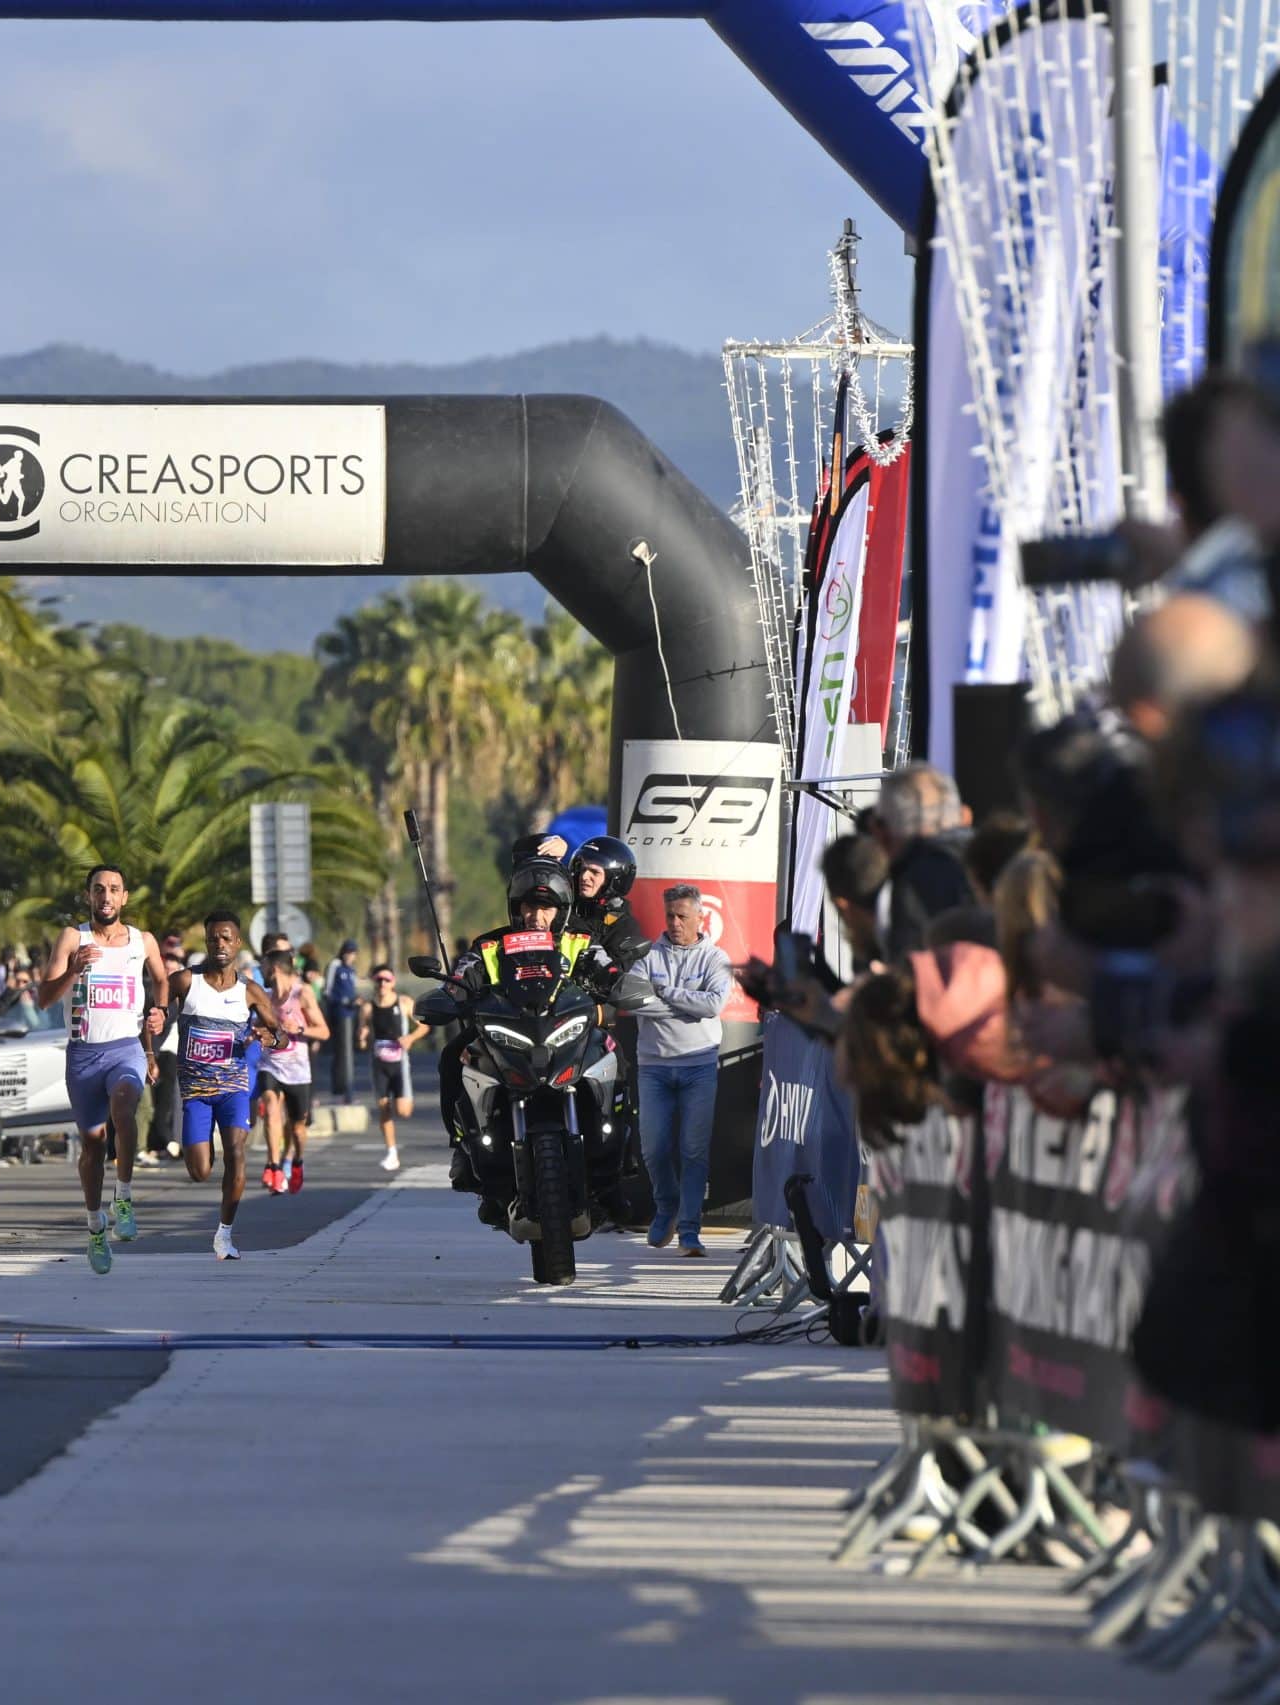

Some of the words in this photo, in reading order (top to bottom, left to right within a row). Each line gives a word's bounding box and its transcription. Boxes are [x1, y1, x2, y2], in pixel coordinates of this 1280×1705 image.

[800, 21, 937, 158] MIZ
[60, 454, 365, 496] CREASPORTS
[59, 501, 267, 524] ORGANISATION
[626, 774, 774, 836] SB
[627, 837, 748, 848] CONSULT
[194, 1041, 224, 1060] 0055
